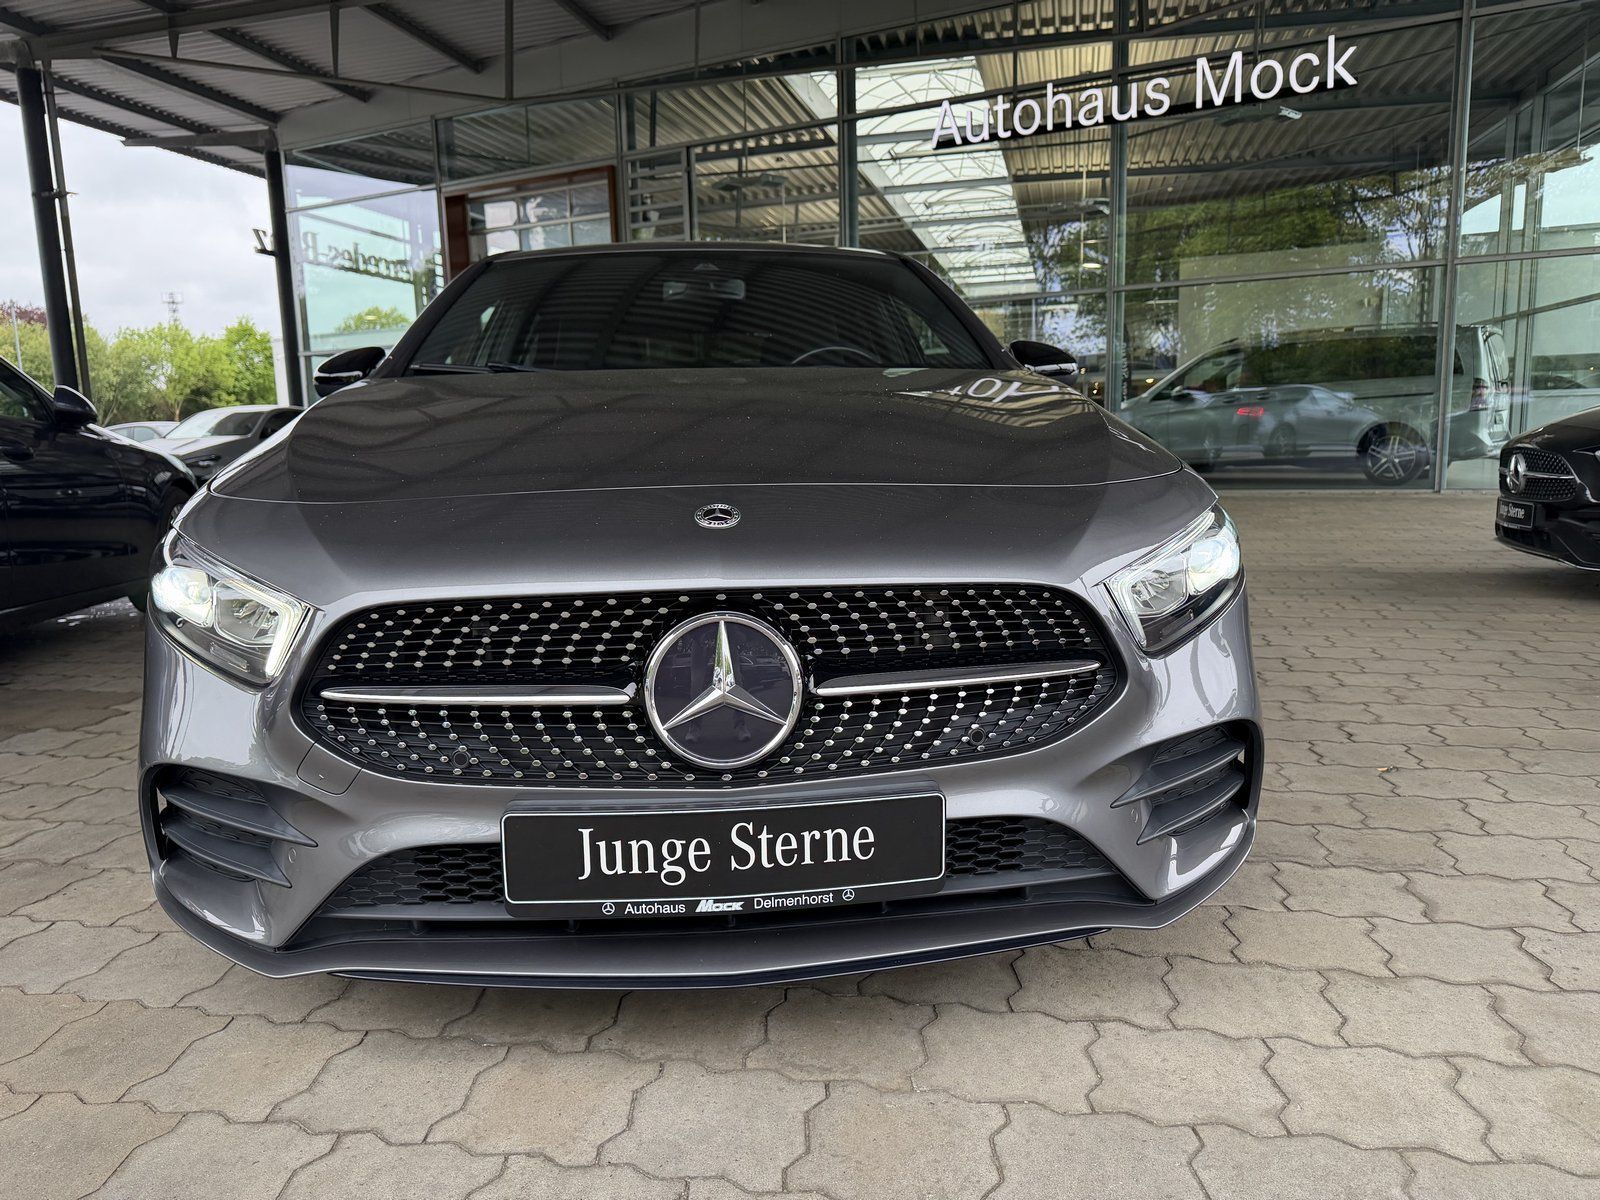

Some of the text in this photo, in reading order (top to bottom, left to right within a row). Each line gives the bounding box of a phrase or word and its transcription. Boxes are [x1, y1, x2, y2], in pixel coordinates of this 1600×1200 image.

[931, 34, 1358, 149] Autohaus Mock
[577, 821, 876, 887] Junge Sterne
[624, 901, 686, 915] Autohaus
[754, 892, 834, 909] Delmenhorst
